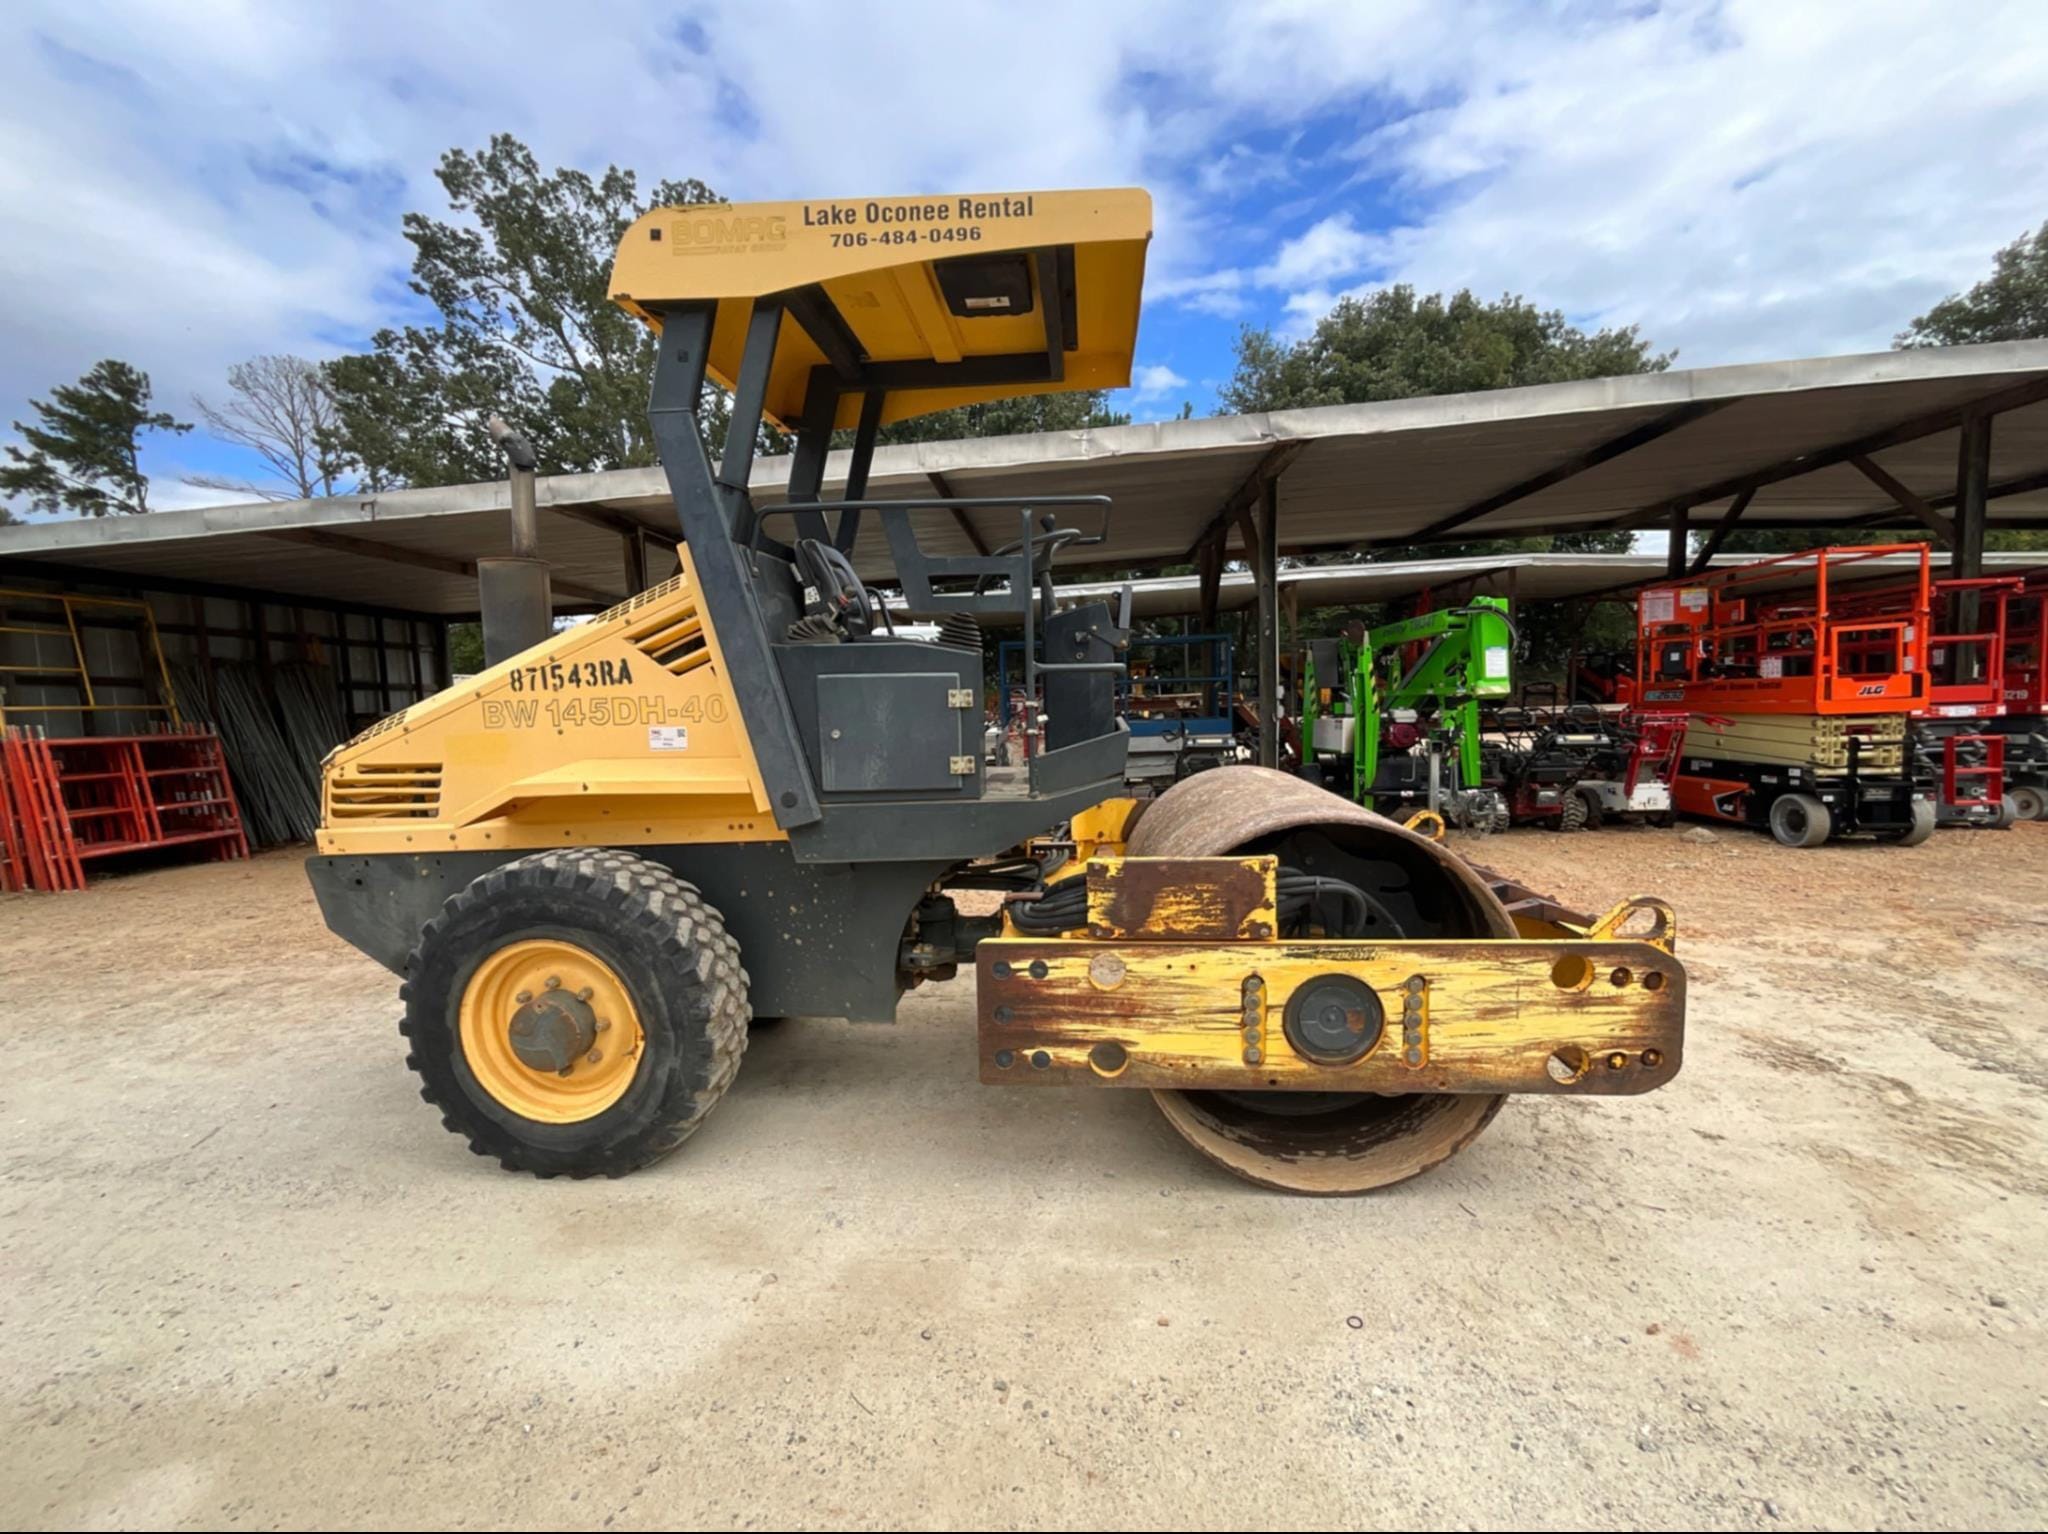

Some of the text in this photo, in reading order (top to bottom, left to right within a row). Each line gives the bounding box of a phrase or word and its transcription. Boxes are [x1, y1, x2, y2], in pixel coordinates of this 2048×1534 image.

[804, 196, 1034, 226] Lake Oconee Rental
[671, 215, 786, 246] BOMAG
[830, 226, 982, 248] 706-484-0496
[510, 658, 633, 692] 871543RA
[1857, 685, 1886, 696] JLG
[482, 693, 729, 729] BW 145DH-40
